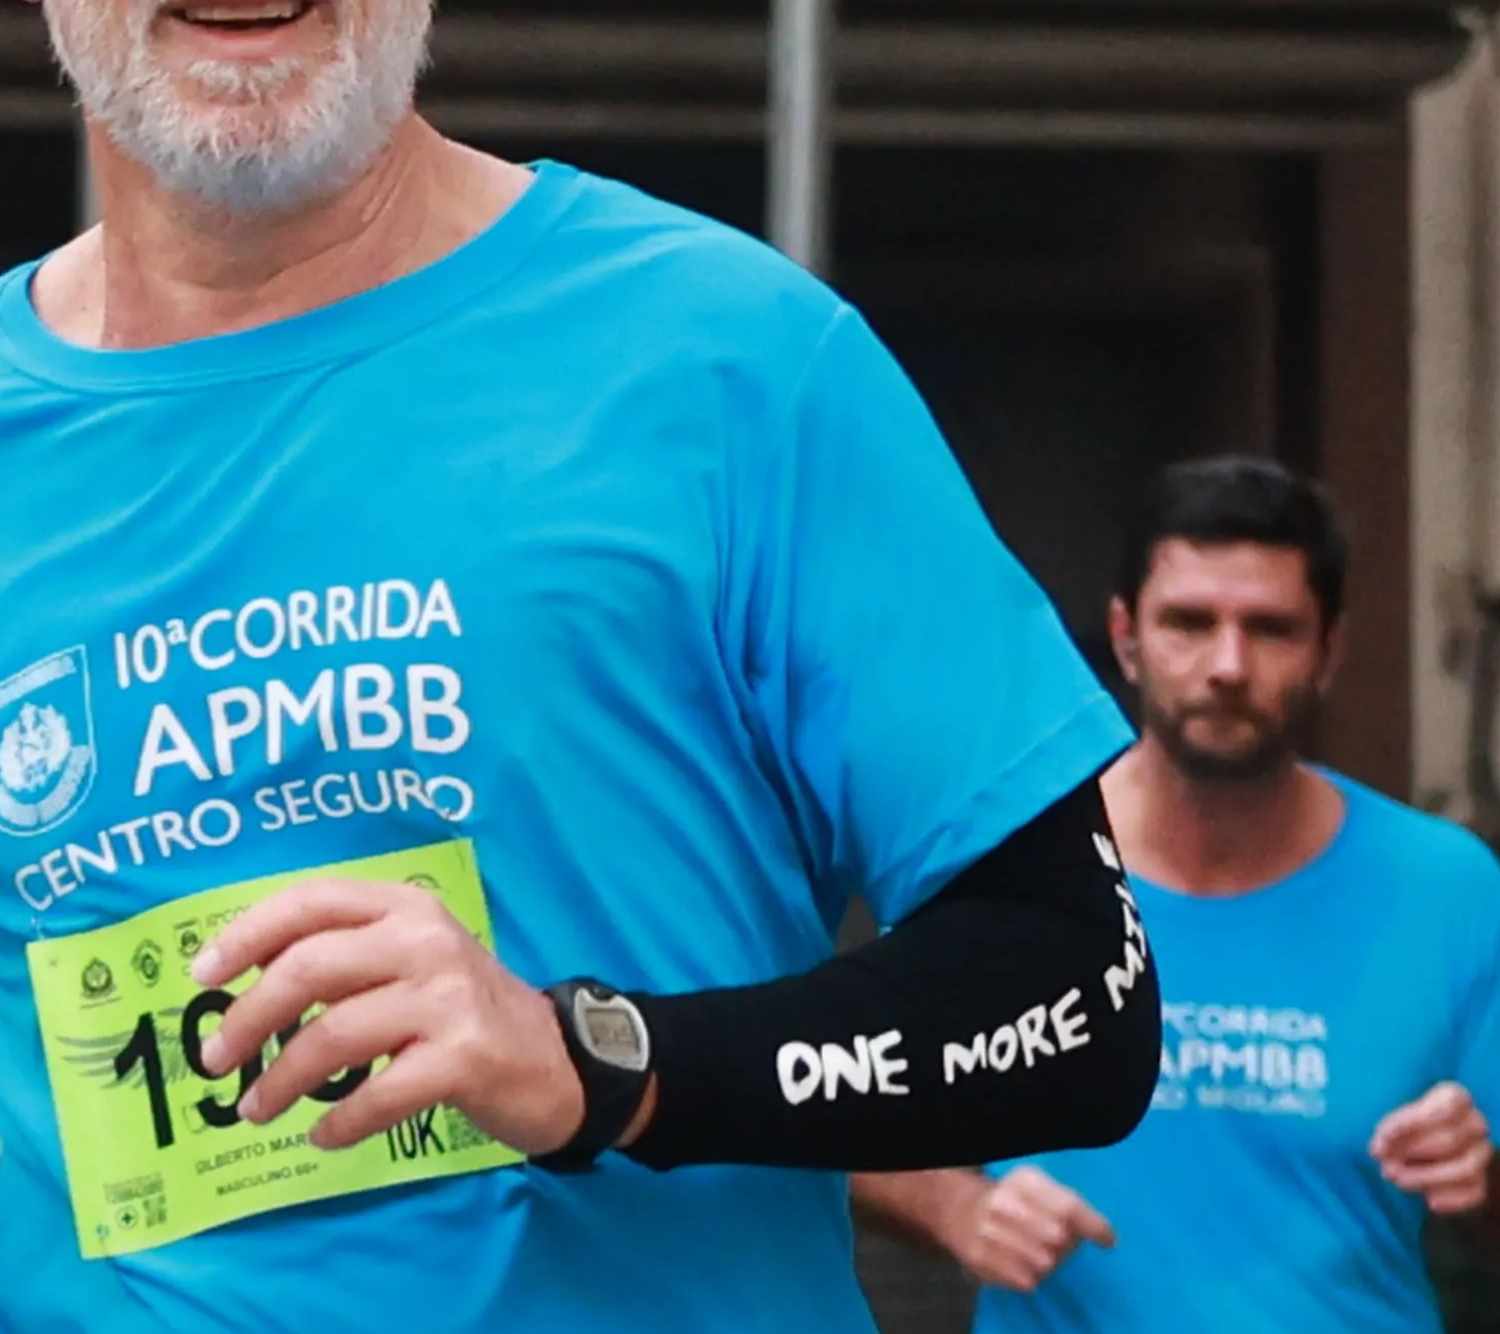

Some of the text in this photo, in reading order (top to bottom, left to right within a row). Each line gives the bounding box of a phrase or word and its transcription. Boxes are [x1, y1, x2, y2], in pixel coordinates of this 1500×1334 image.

[133, 663, 471, 798] APMBB
[14, 768, 474, 911] CENTRO SEGURO
[776, 987, 1091, 1106] ONE MORE
[269, 1132, 309, 1153] MAR
[386, 1106, 446, 1162] 10K
[216, 1165, 292, 1196] MASCULINO
